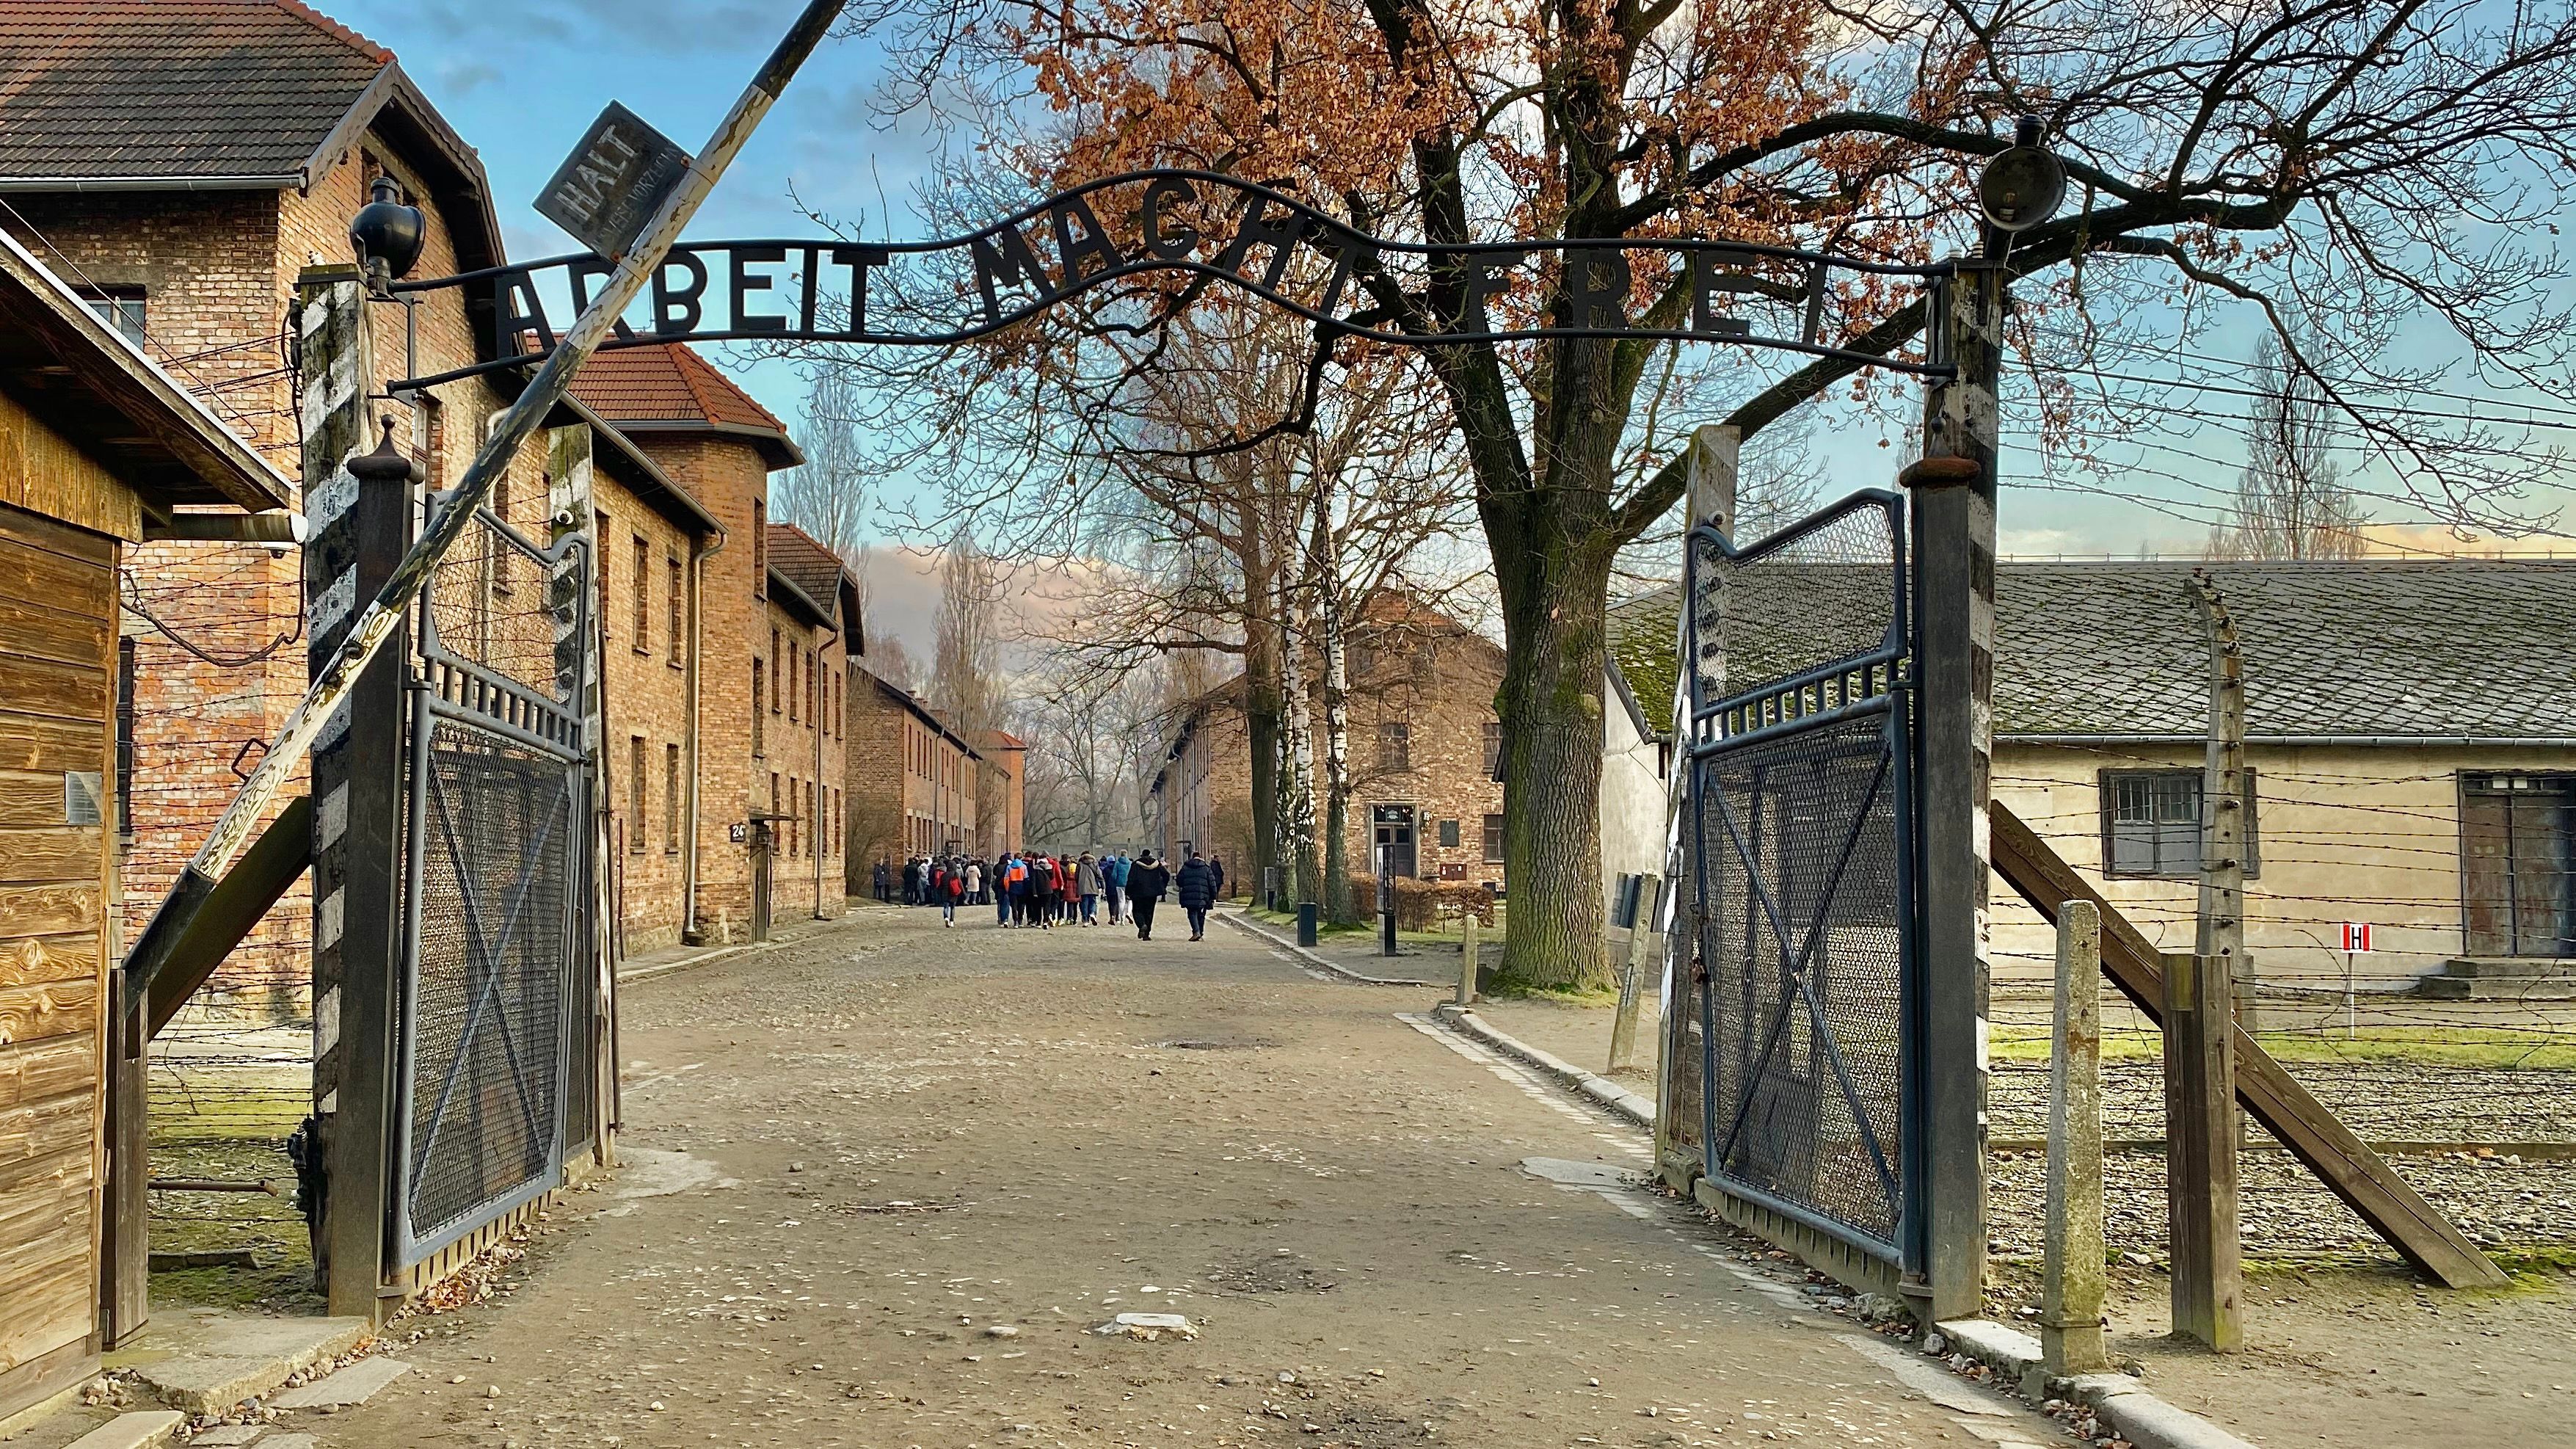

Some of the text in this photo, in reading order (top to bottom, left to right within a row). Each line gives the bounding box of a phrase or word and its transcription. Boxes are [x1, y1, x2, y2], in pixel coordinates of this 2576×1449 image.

[555, 124, 637, 221] HALT
[495, 178, 1827, 358] ARBEIT MACHT FREI
[2351, 927, 2362, 949] H
